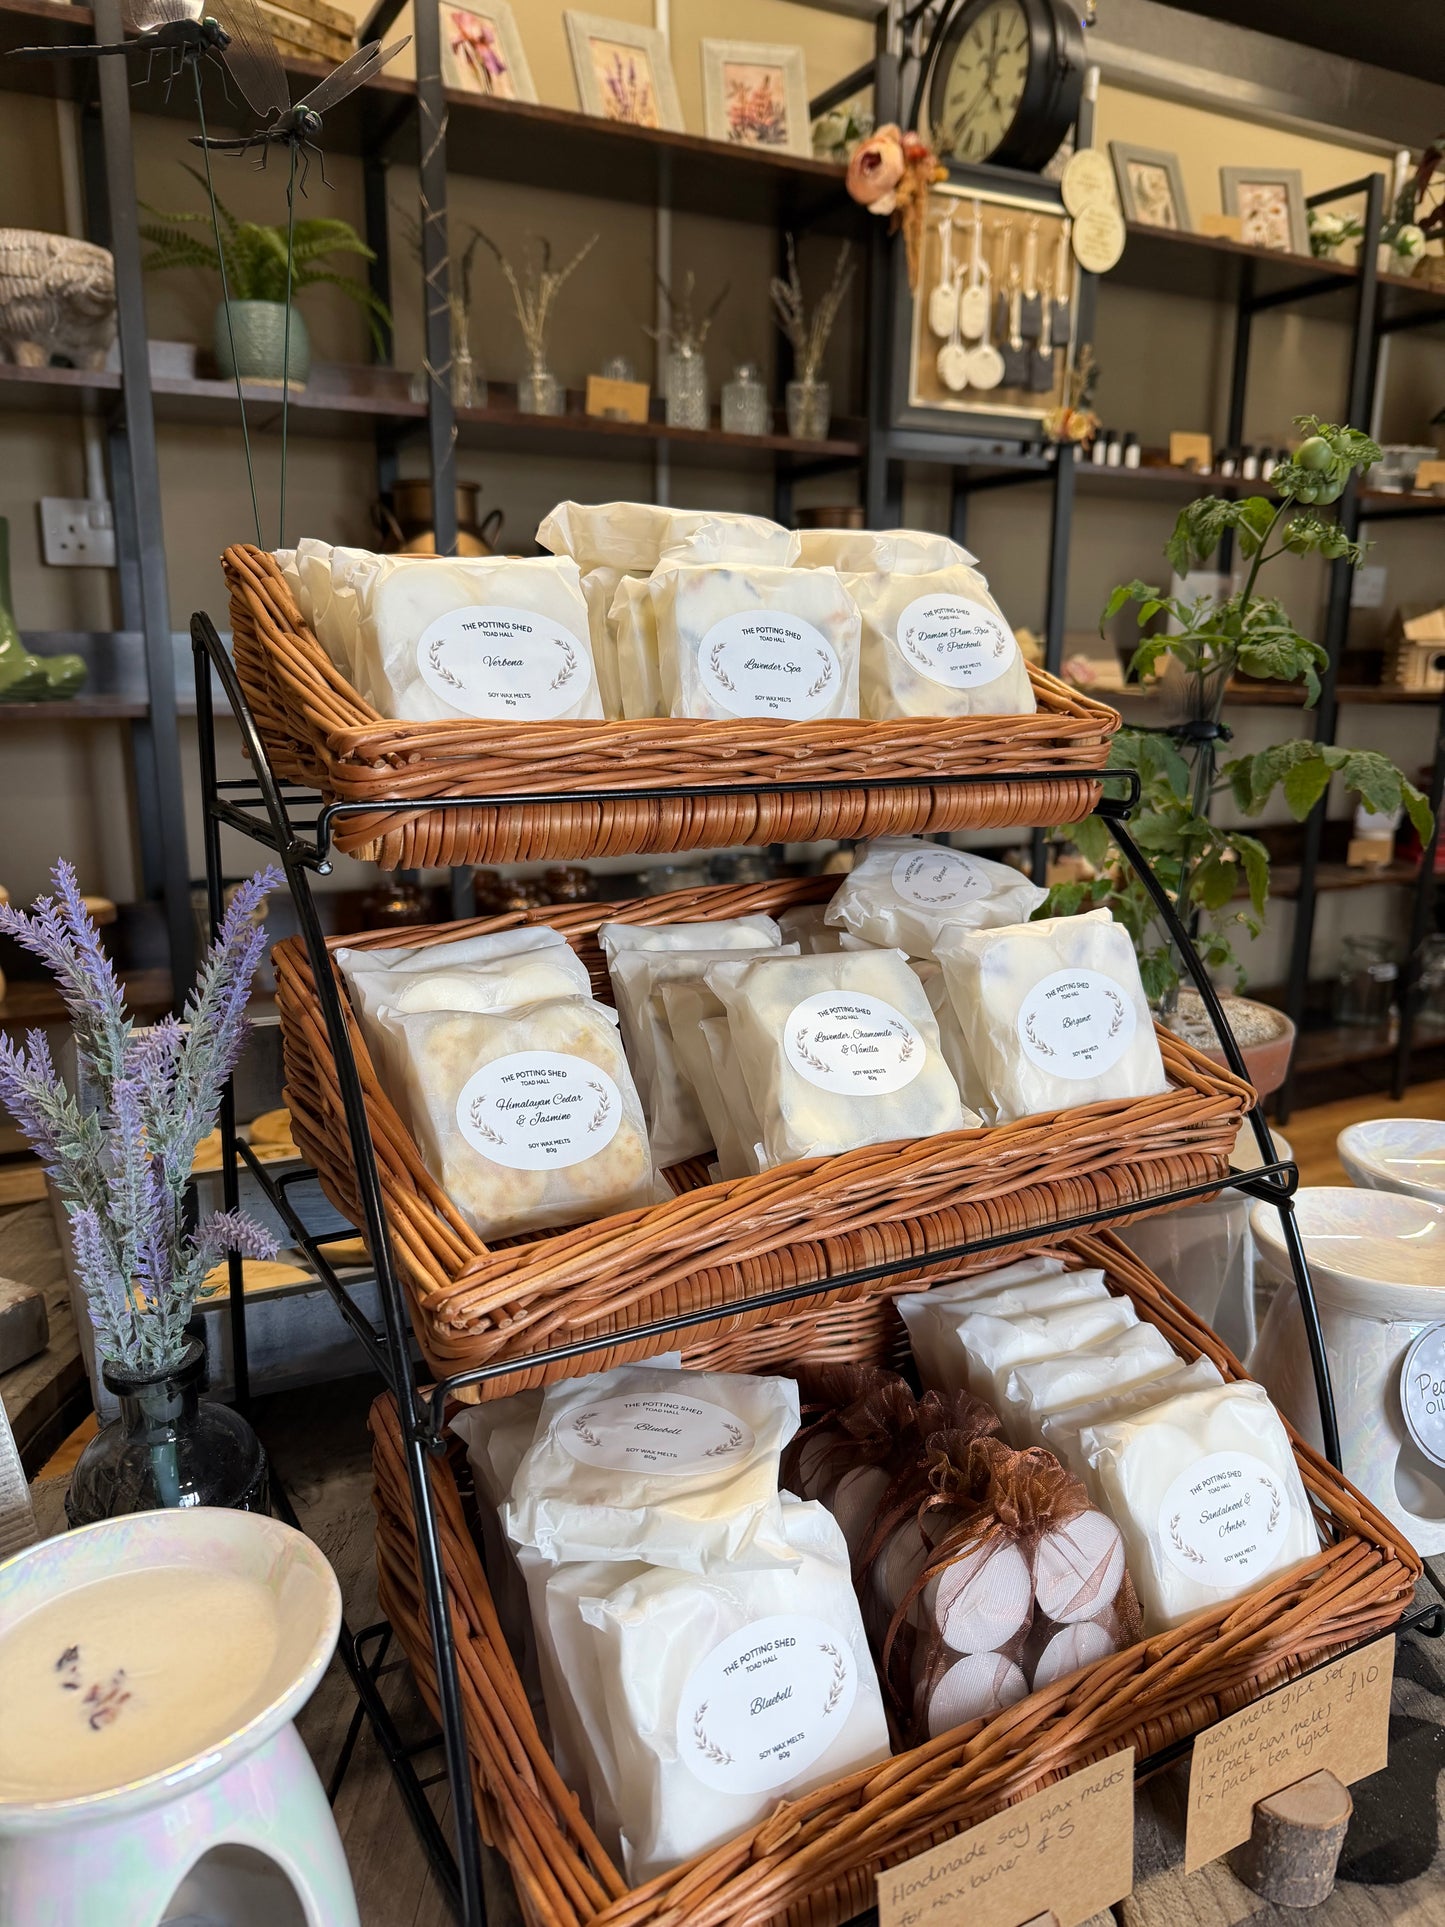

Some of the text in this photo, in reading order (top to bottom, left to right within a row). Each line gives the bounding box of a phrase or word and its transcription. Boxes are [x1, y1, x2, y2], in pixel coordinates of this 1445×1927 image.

[923, 610, 934, 618] THE
[955, 608, 970, 616] SHED
[461, 621, 533, 633] THE POTTING SHED
[741, 626, 802, 641] THE POTTING SHED
[918, 631, 948, 641] Damson
[936, 640, 982, 654] & Patchouli
[482, 656, 524, 667] Verbena
[744, 658, 802, 675] Lavender Spa
[1045, 989, 1057, 1000] THE
[1056, 982, 1076, 994] POTTING
[817, 1006, 872, 1019] THE POTTING SHED
[852, 1028, 892, 1039] Chamomile
[841, 1043, 880, 1056] & Vanilla
[500, 1069, 567, 1084] THE POTTING SHED
[495, 1093, 584, 1111] Himalayan Cedar
[516, 1111, 571, 1128] & Jasmine
[642, 1401, 680, 1410] POTTING
[680, 1405, 703, 1415] SHED
[633, 1423, 684, 1436] Bluebell
[1190, 1470, 1242, 1496] THE POTTING SHED
[1208, 1482, 1232, 1495] TOAD HALL
[1199, 1492, 1252, 1524] Sandalwood &
[1218, 1518, 1247, 1538] Amber
[1224, 1544, 1257, 1563] SOY WAX MELTS
[722, 1637, 797, 1676] THE POTTING SHED
[745, 1654, 778, 1673] TOAD HALL
[1345, 1665, 1380, 1703] £10
[750, 1685, 794, 1716] Bluebell
[1203, 1663, 1347, 1750] wax melt gift set
[759, 1732, 805, 1760] SOY WAX MELTS
[1222, 1750, 1251, 1777] pack
[1259, 1732, 1286, 1752] wax
[1289, 1701, 1333, 1737] melts
[778, 1750, 791, 1761] 80g
[1221, 1766, 1258, 1799] pack
[1267, 1749, 1290, 1768] tea
[1296, 1722, 1333, 1757] light
[891, 1768, 1126, 1907] Handmade soy wax melts
[1036, 1817, 1076, 1855] £5
[895, 1909, 923, 1927] for
[931, 1886, 966, 1909] wax
